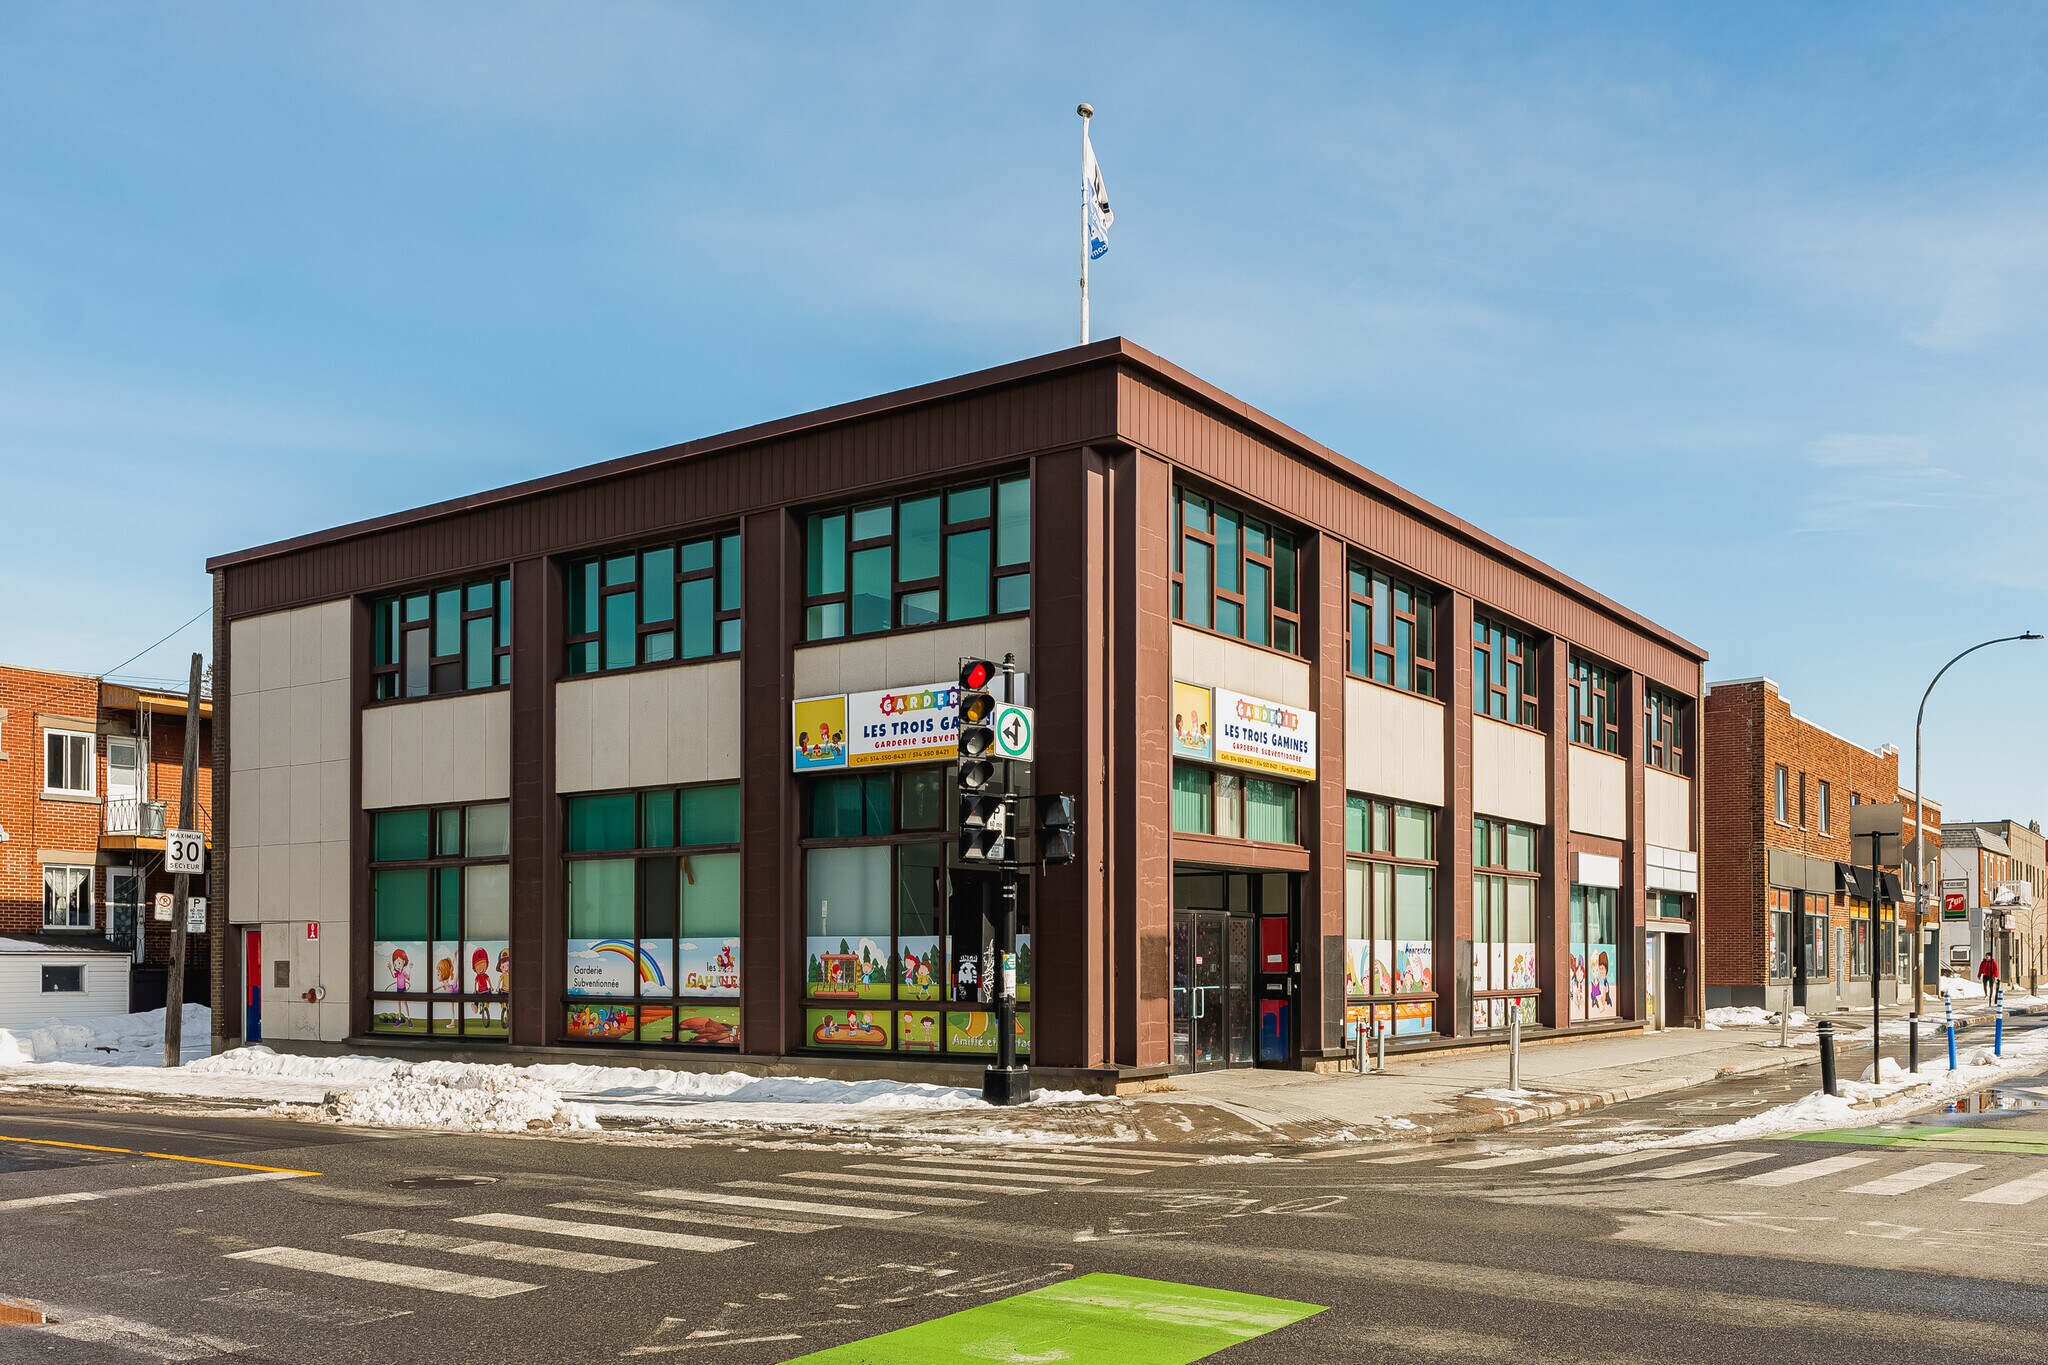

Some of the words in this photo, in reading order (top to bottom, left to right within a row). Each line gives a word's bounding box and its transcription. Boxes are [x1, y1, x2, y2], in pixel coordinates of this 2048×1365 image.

[1238, 703, 1297, 728] GARDERIE
[863, 723, 887, 738] LES
[891, 718, 934, 736] TROIS
[1225, 723, 1239, 739] LES
[1242, 727, 1268, 744] TROIS
[1271, 733, 1308, 753] GAMINES
[171, 840, 200, 862] 30
[170, 862, 200, 870] SECTEUR
[573, 965, 603, 975] Garderie
[706, 961, 717, 972] les
[573, 978, 620, 988] Subventionnée
[687, 973, 740, 989] GAMINE
